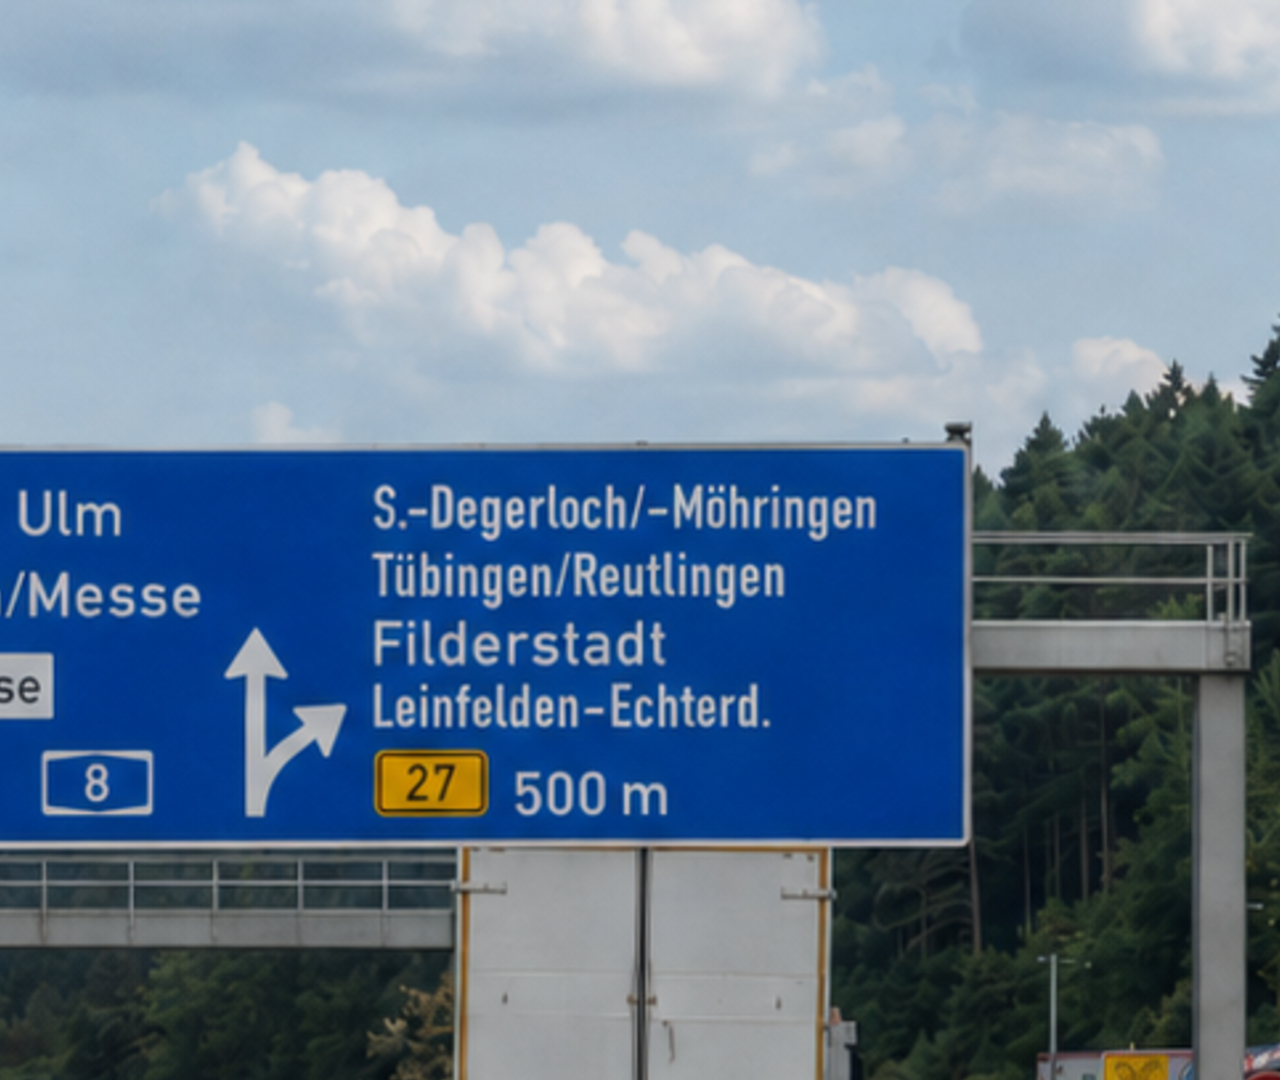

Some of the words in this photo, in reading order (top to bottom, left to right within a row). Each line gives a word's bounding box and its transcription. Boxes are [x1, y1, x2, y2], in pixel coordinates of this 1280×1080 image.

[18, 490, 122, 537] Ulm
[373, 484, 877, 541] S.-Degerloch/-Möhringen
[372, 551, 786, 609] Tübingen/Reutlingen
[373, 620, 667, 667] Filderstadt
[373, 683, 771, 729] Leinfelden-Echterd.
[84, 763, 110, 802] 8
[405, 763, 456, 803] 27
[514, 771, 607, 816] 500
[622, 781, 668, 816] m
